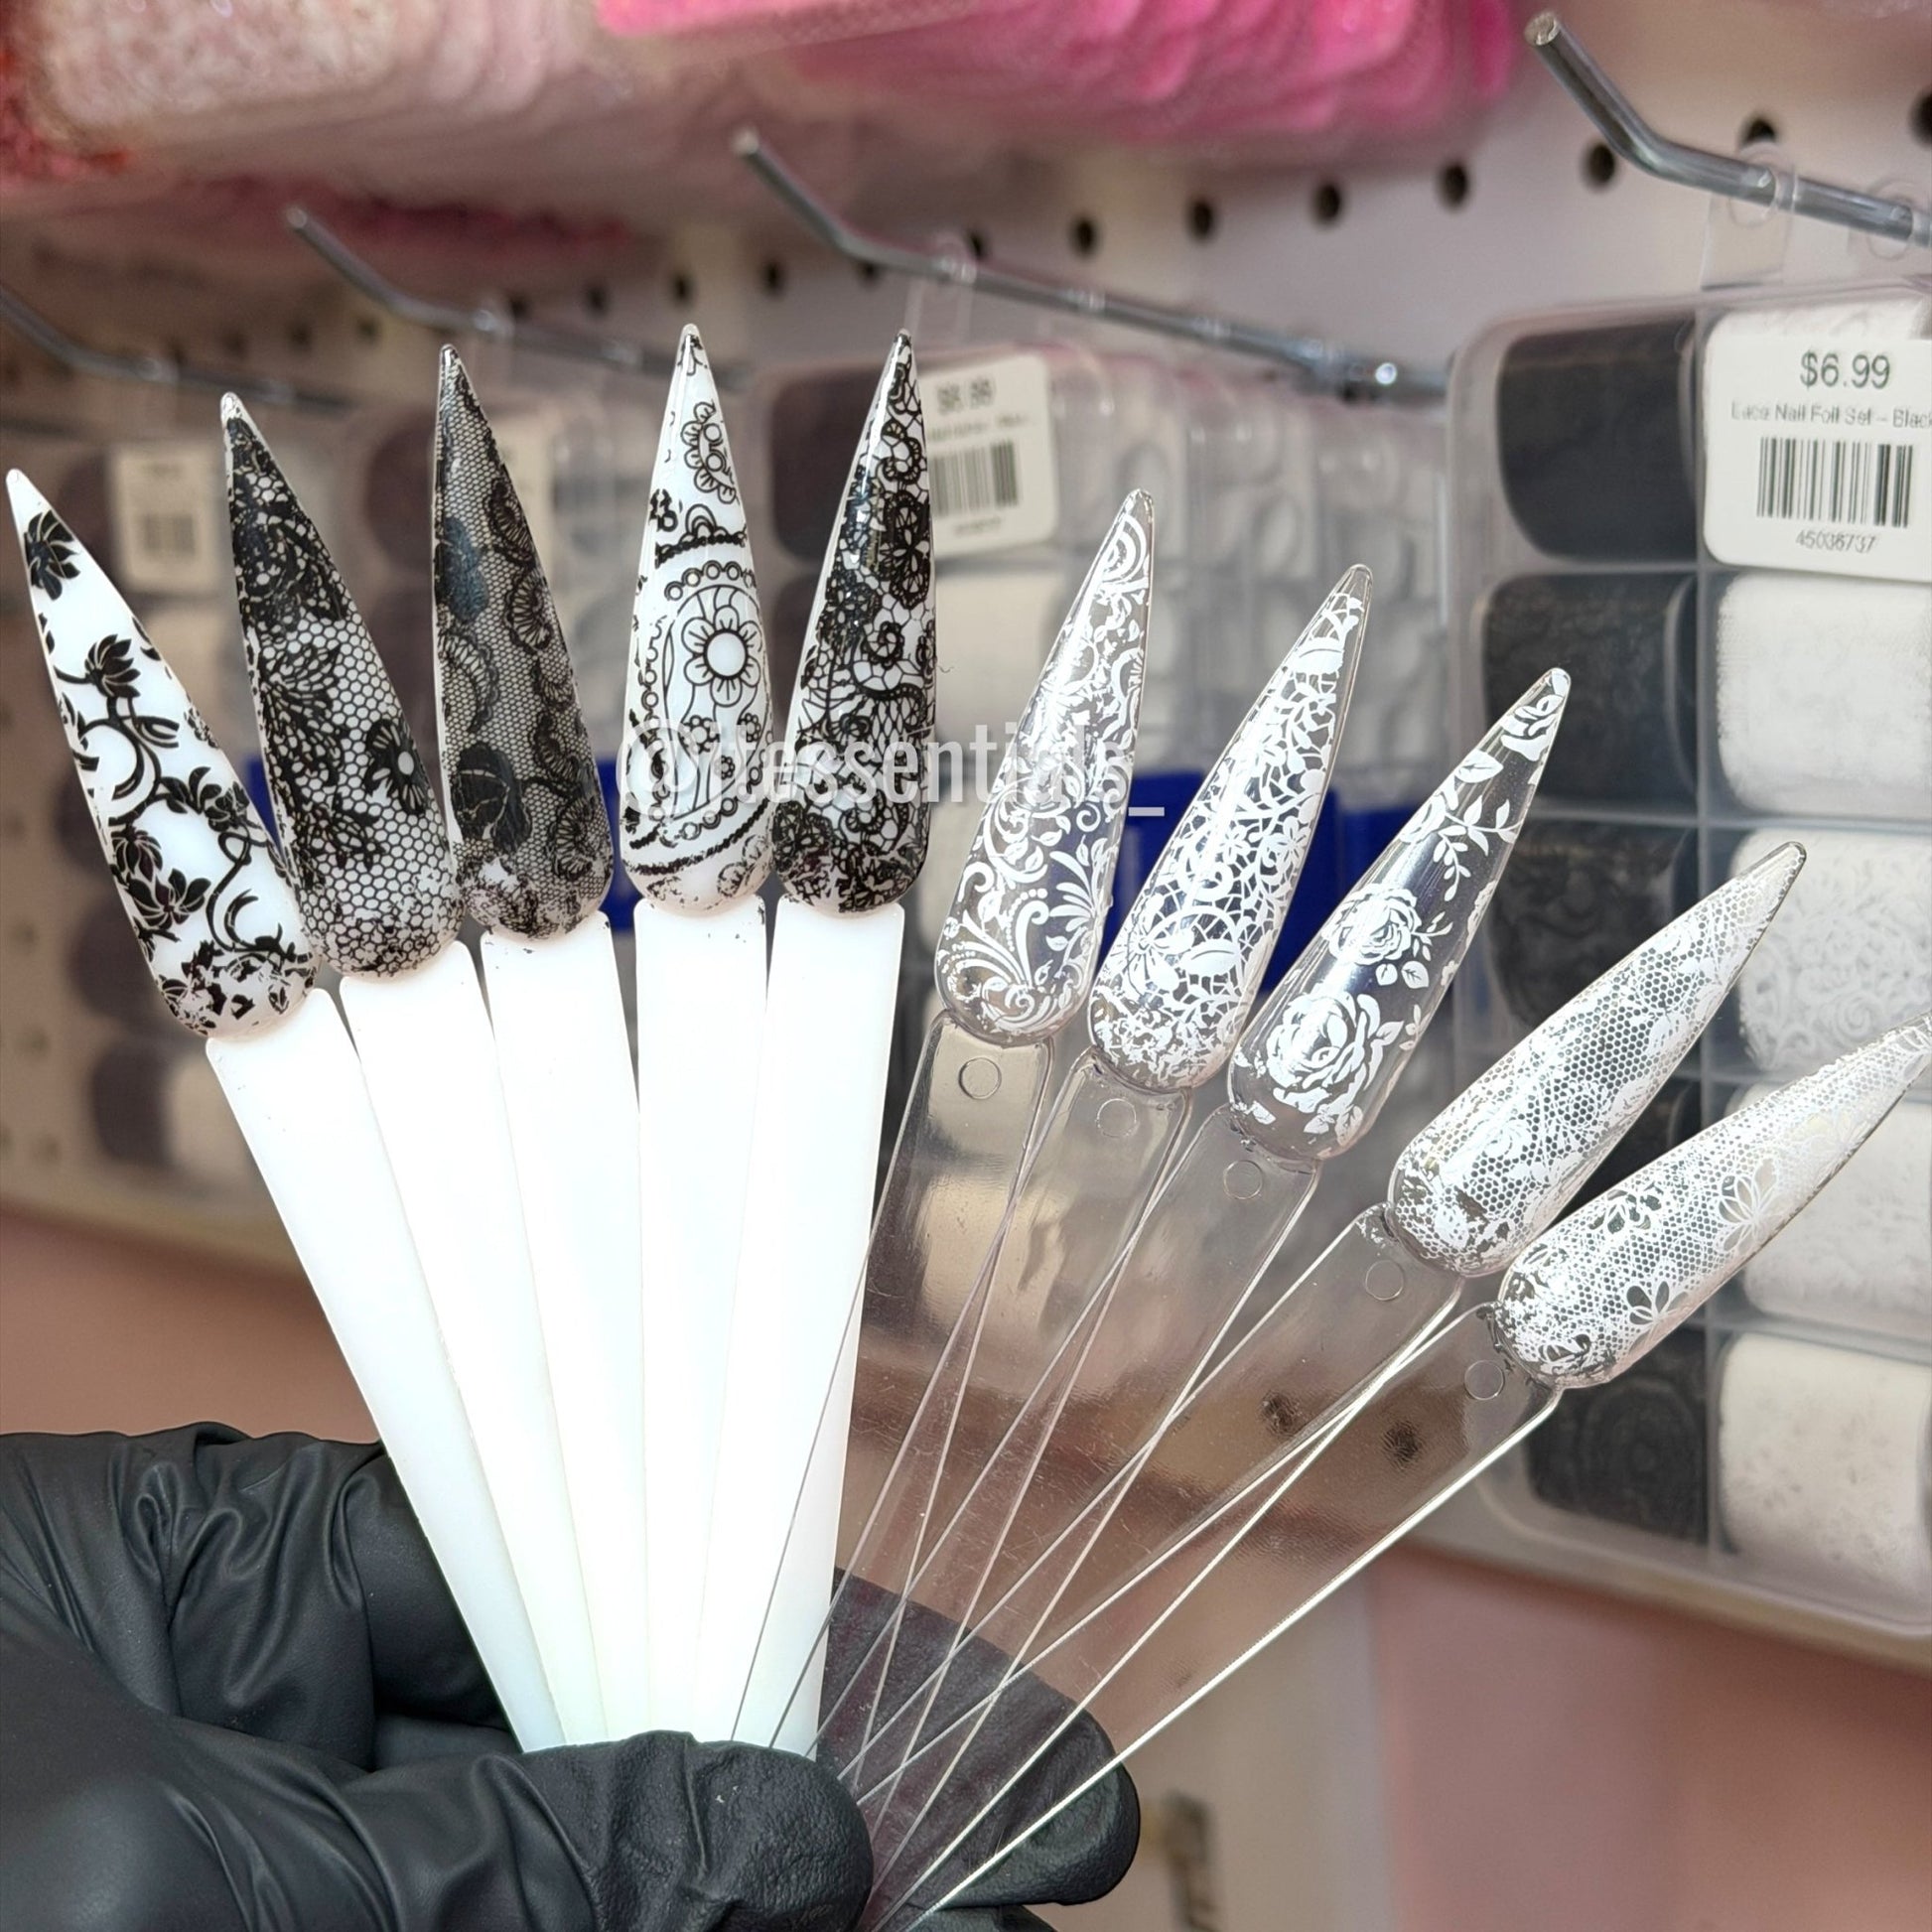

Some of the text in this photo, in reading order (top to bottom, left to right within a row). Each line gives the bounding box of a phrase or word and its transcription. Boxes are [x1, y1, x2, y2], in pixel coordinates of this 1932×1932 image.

[1800, 349, 1890, 389] $6.99
[1730, 400, 1769, 421] Lace
[1775, 402, 1806, 422] Nail
[1810, 403, 1840, 424] Foil
[1845, 406, 1871, 426] Set
[1795, 529, 1876, 554] 45036737
